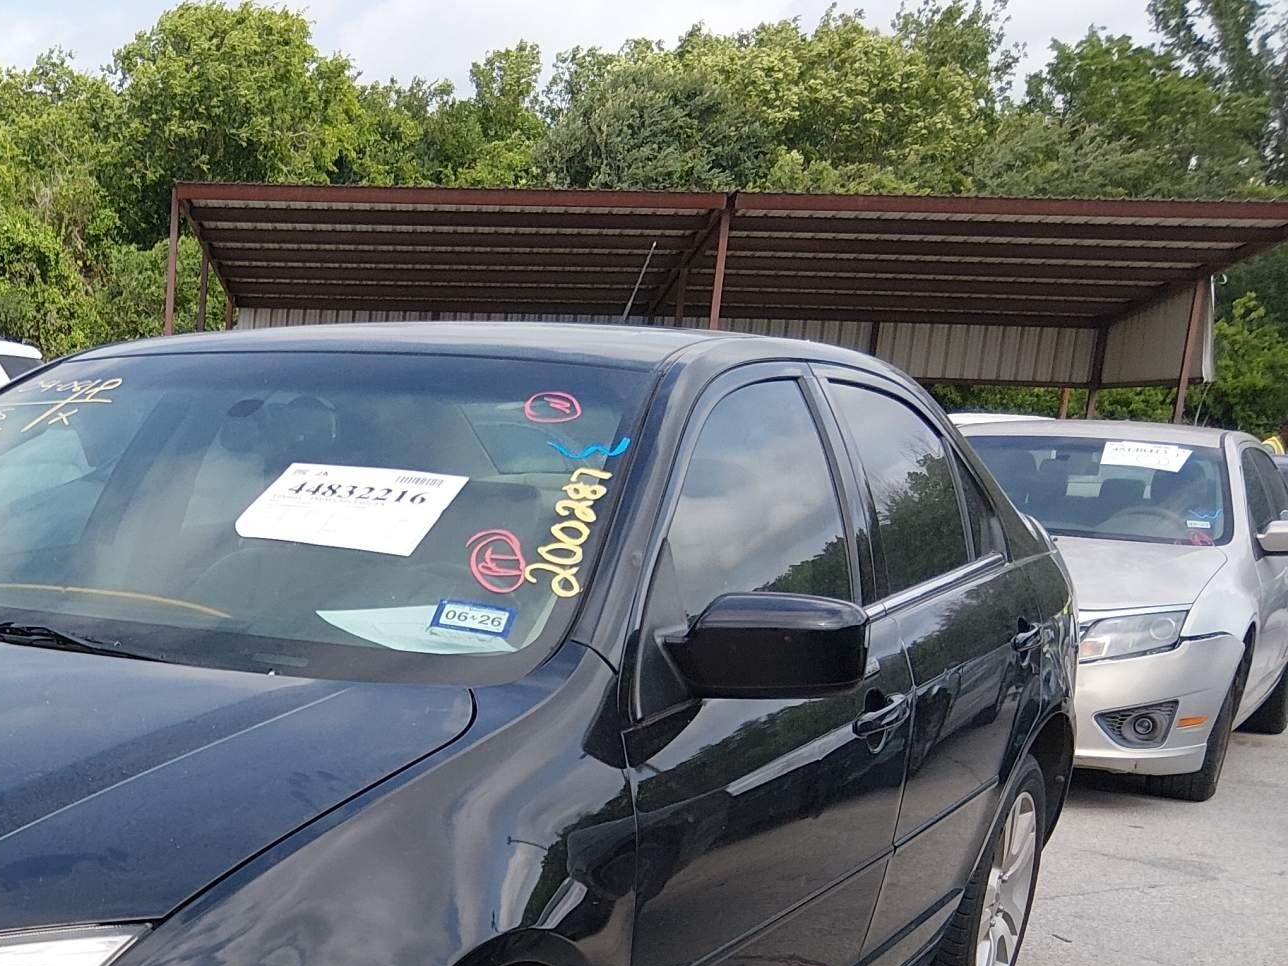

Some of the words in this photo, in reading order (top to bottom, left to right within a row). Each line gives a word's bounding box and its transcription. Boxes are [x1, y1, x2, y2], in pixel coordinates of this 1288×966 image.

[288, 481, 428, 505] 44832216
[524, 467, 613, 598] 200287
[445, 609, 469, 623] 06
[478, 614, 503, 628] 26
